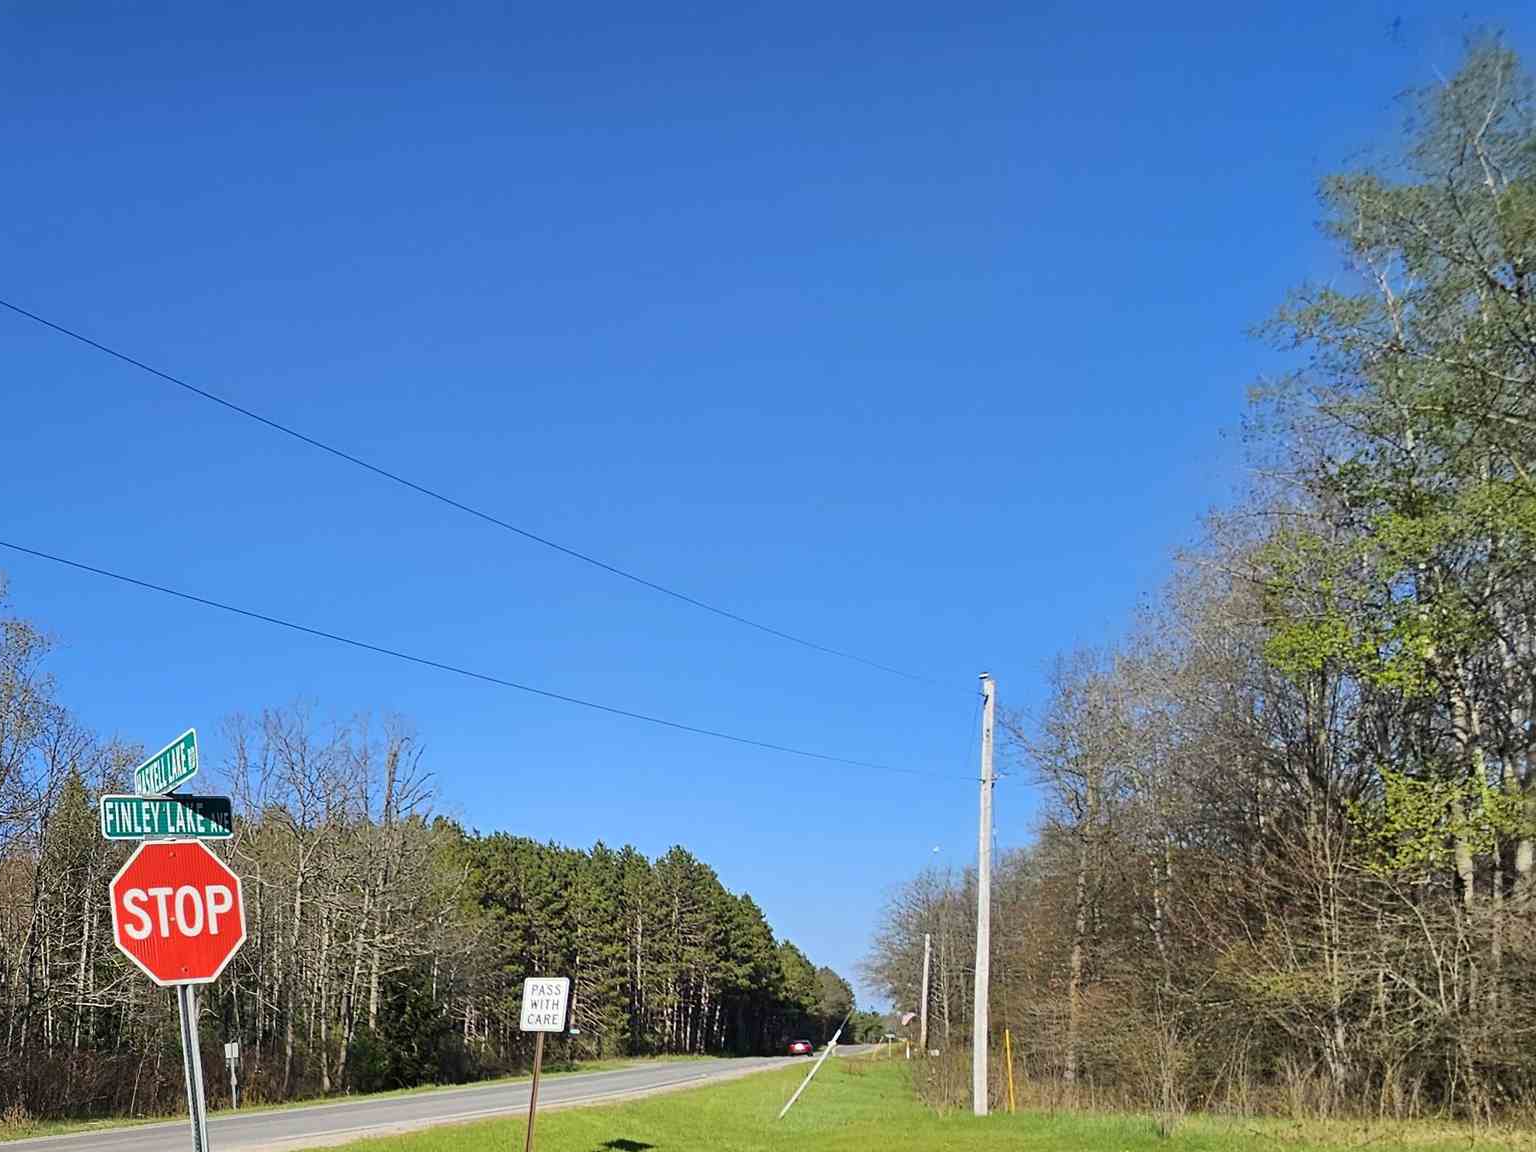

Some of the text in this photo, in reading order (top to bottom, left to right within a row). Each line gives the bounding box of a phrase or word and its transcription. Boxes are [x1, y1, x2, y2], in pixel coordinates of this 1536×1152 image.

[167, 741, 186, 783] LAKE
[105, 801, 231, 833] FINLEY LAKE AVE
[123, 885, 233, 940] STOP
[531, 984, 561, 996] PASS
[530, 999, 559, 1010] WITH
[527, 1014, 558, 1025] CARE
